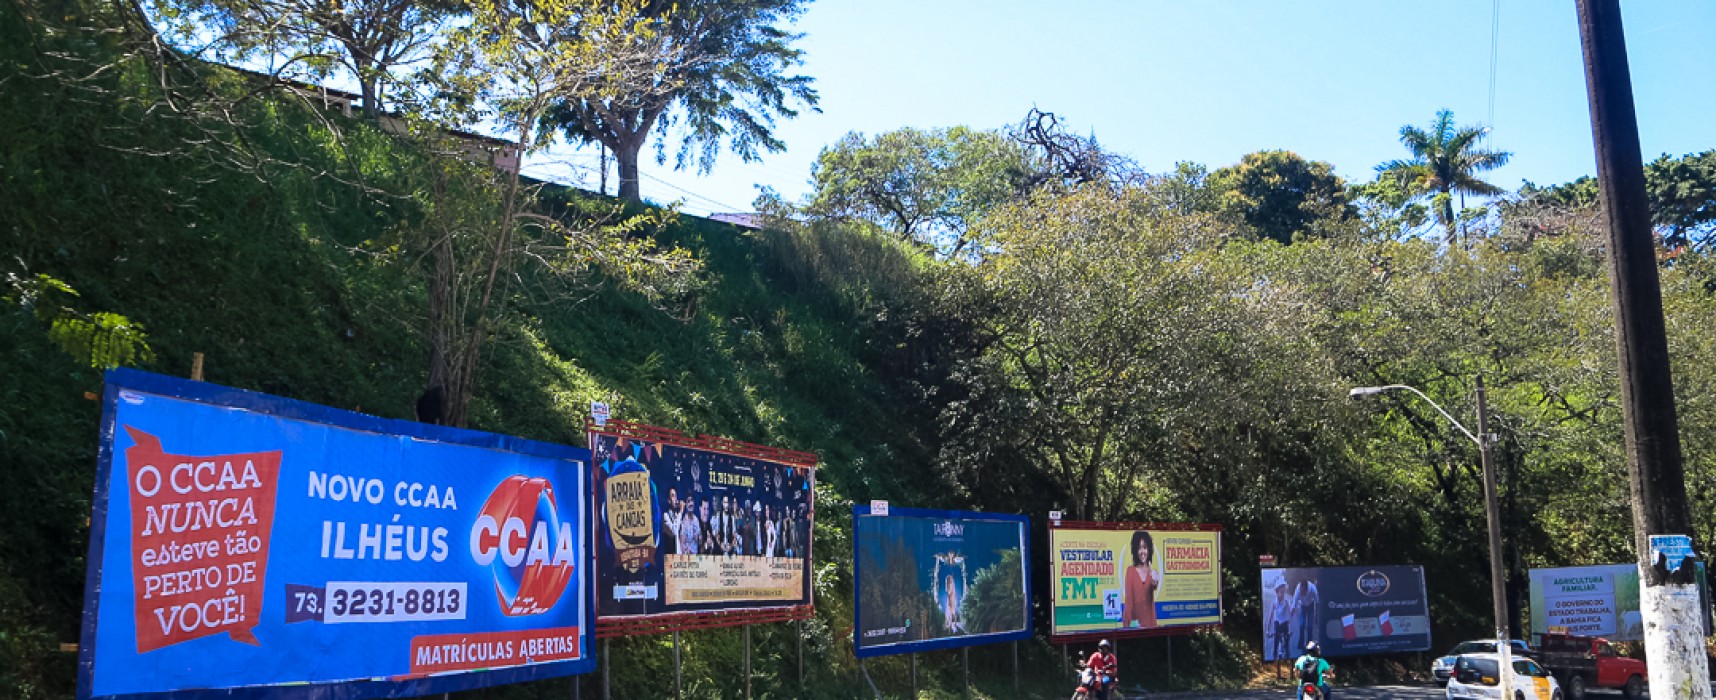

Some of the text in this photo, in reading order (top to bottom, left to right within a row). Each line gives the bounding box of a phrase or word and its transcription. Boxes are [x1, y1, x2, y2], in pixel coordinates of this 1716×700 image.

[135, 459, 262, 497] O CCAA
[308, 471, 458, 510] NOVO CCAA
[141, 497, 259, 537] NUNCA
[141, 530, 261, 567] esteve tão
[320, 511, 449, 562] ILHÉUS
[469, 515, 575, 567] CCAA
[1060, 549, 1113, 561] VESTIBULAR
[143, 562, 257, 599] PERTO DE
[1061, 562, 1115, 577] AGENDADO
[1554, 577, 1603, 585] AGRICULTURA
[294, 588, 461, 616] 73. 3231-8813
[1061, 577, 1099, 600] FMT
[154, 588, 246, 636] VOCÊ!
[416, 635, 574, 667] MATRÍCULAS ABERTAS
